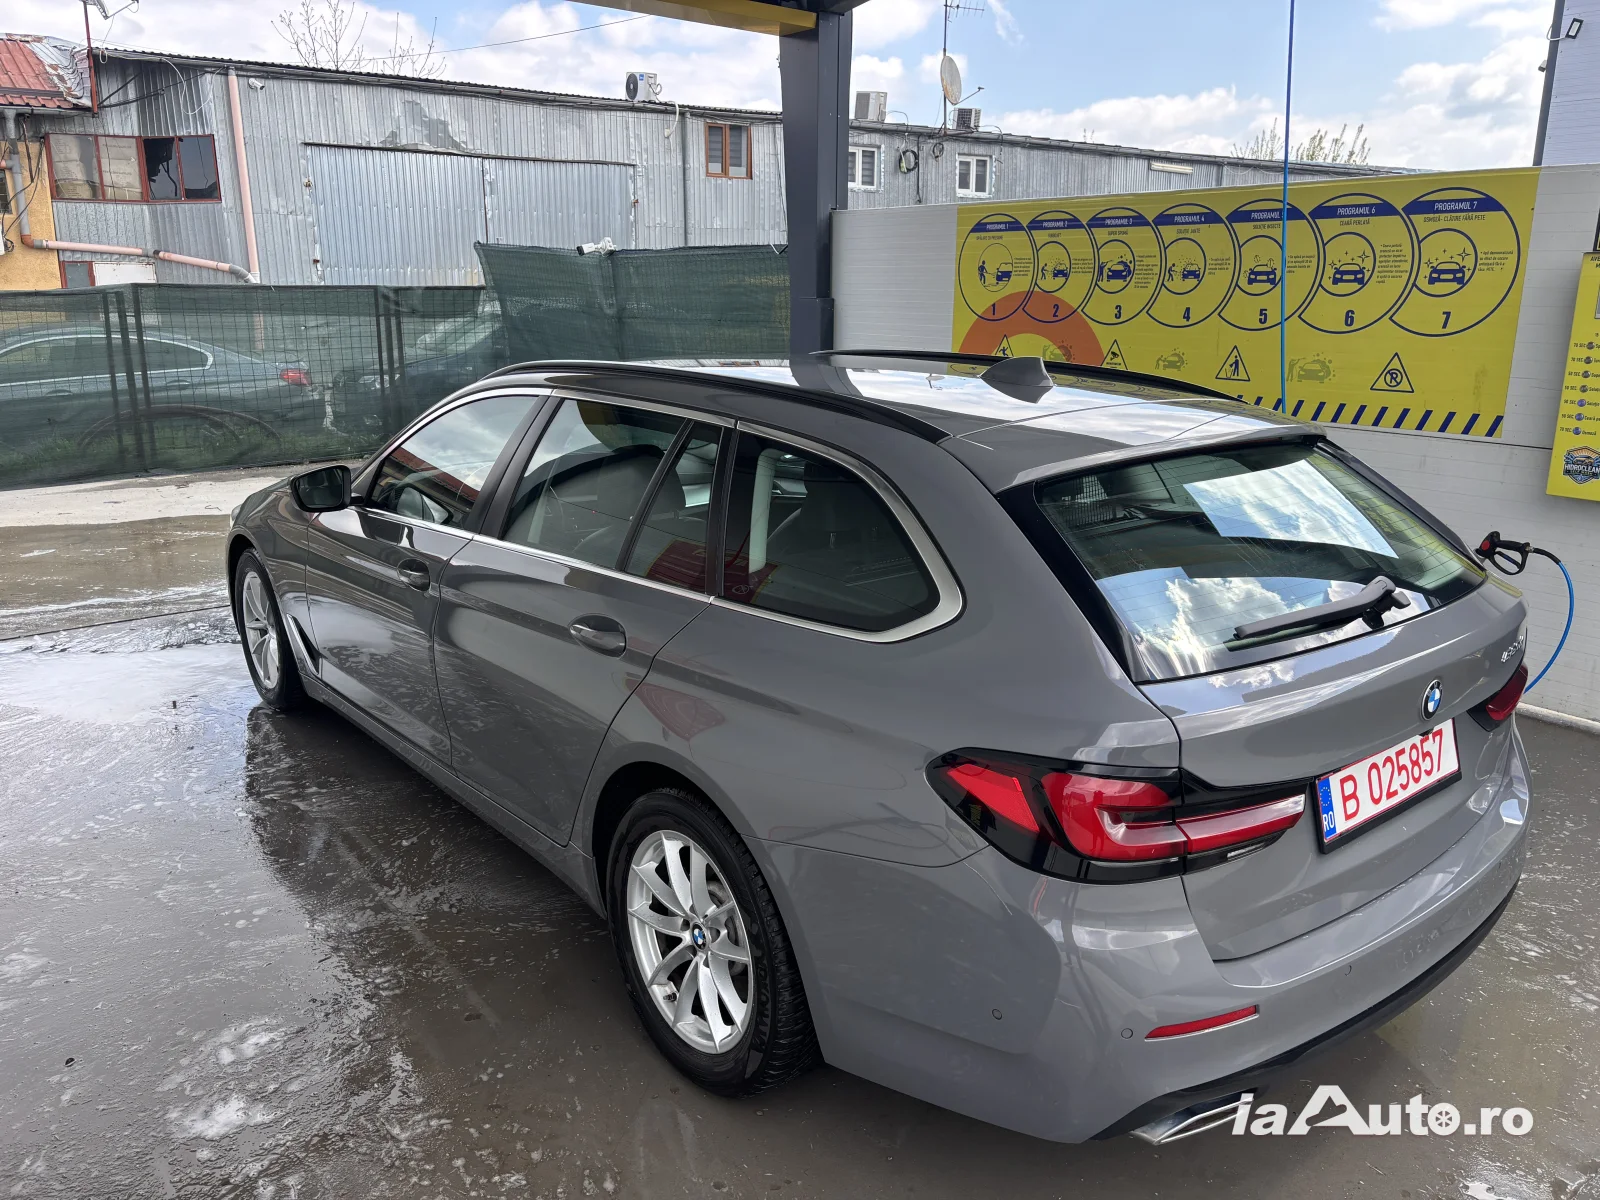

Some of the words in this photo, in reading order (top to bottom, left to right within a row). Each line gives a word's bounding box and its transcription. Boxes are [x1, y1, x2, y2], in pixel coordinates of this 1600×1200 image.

[1336, 207, 1370, 216] PROGRAMUL
[1434, 202, 1472, 211] PROGRAMUL
[1174, 215, 1200, 223] PROGRAMUL
[1250, 212, 1280, 220] PROGRAMUL
[990, 304, 996, 316] 1
[1052, 304, 1059, 318] 2
[1114, 304, 1122, 320] 3
[1182, 306, 1191, 322] 4
[1258, 308, 1268, 324] 5
[1344, 309, 1355, 327] 6
[1441, 310, 1452, 330] 7
[1340, 773, 1360, 822] B
[1367, 728, 1444, 806] 025857
[1322, 810, 1334, 832] RO
